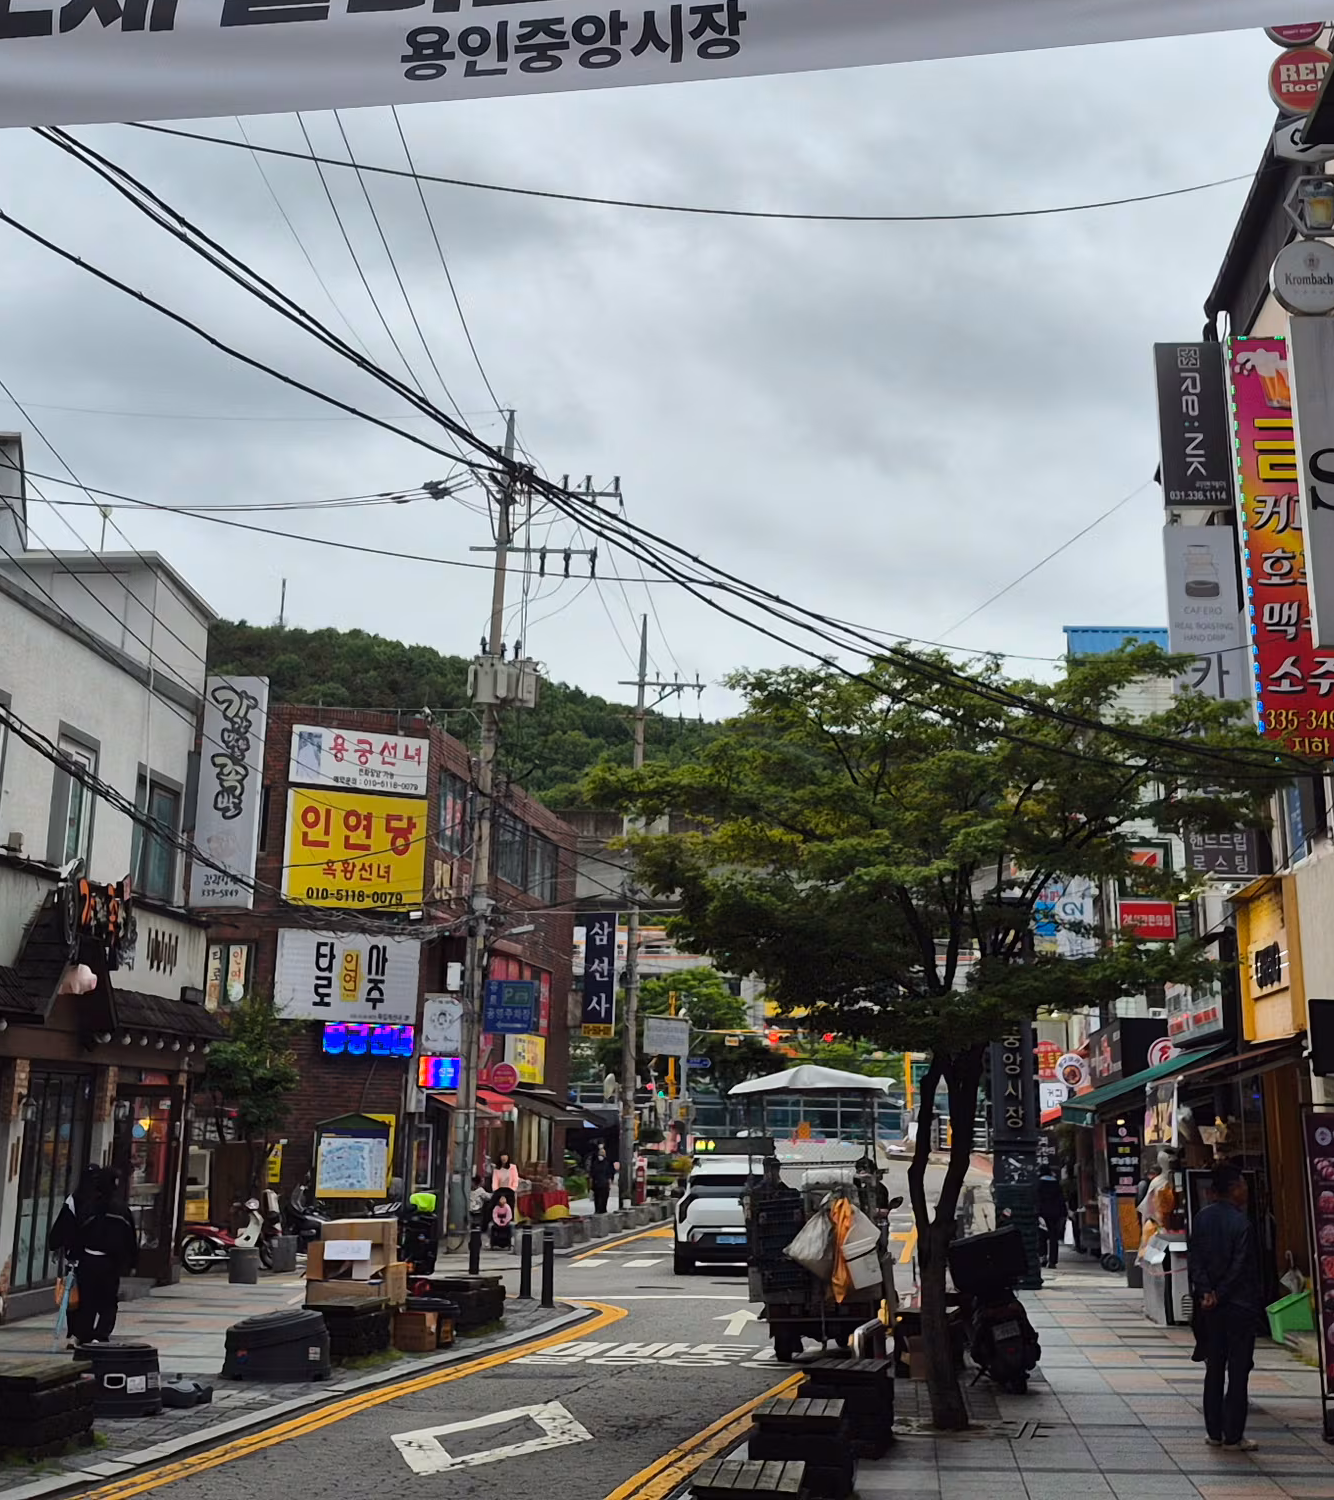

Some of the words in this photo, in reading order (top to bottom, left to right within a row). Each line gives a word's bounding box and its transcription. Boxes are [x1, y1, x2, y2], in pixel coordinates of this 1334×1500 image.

[397, 2, 748, 83] 용인중앙시장
[1281, 80, 1323, 93] Roc
[1169, 489, 1228, 501] 031.336.1114
[1257, 547, 1309, 587] 호
[1261, 600, 1312, 641] 맥
[328, 733, 422, 766] 용궁선녀
[1291, 736, 1330, 756] 지하
[363, 778, 419, 791] 010-5118-0079
[300, 805, 417, 857] 인연당
[1189, 834, 1248, 851] 핸드드립
[322, 859, 392, 884] 옥황선녀
[305, 886, 403, 905] 010-5118-0079
[311, 941, 337, 1008] 타로
[342, 953, 359, 993] 인연
[364, 944, 389, 1011] 사주
[586, 920, 613, 1020] 삼선사
[486, 1008, 532, 1021] 공영주차장
